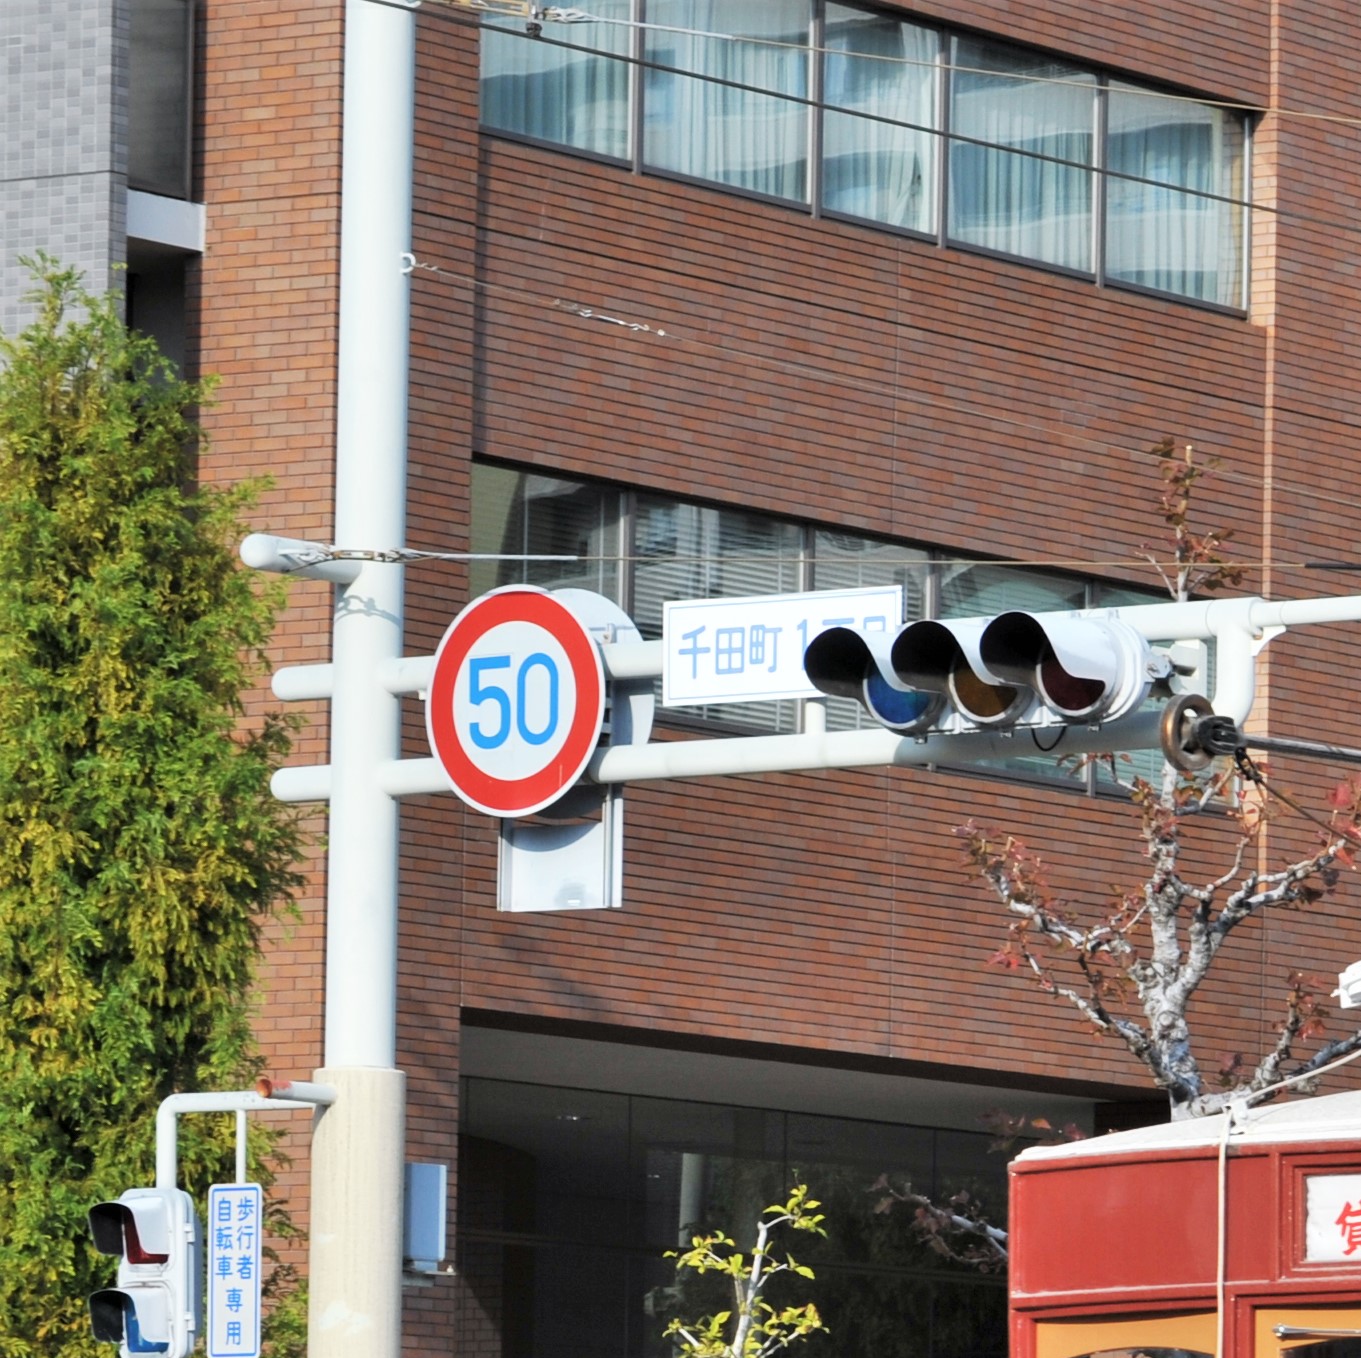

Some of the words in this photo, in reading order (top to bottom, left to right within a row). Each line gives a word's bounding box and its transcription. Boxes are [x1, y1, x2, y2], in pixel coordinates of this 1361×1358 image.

[469, 652, 559, 750] 50
[215, 1196, 233, 1281] 自転車
[236, 1196, 254, 1280] 歩行者
[225, 1287, 244, 1346] 専用
